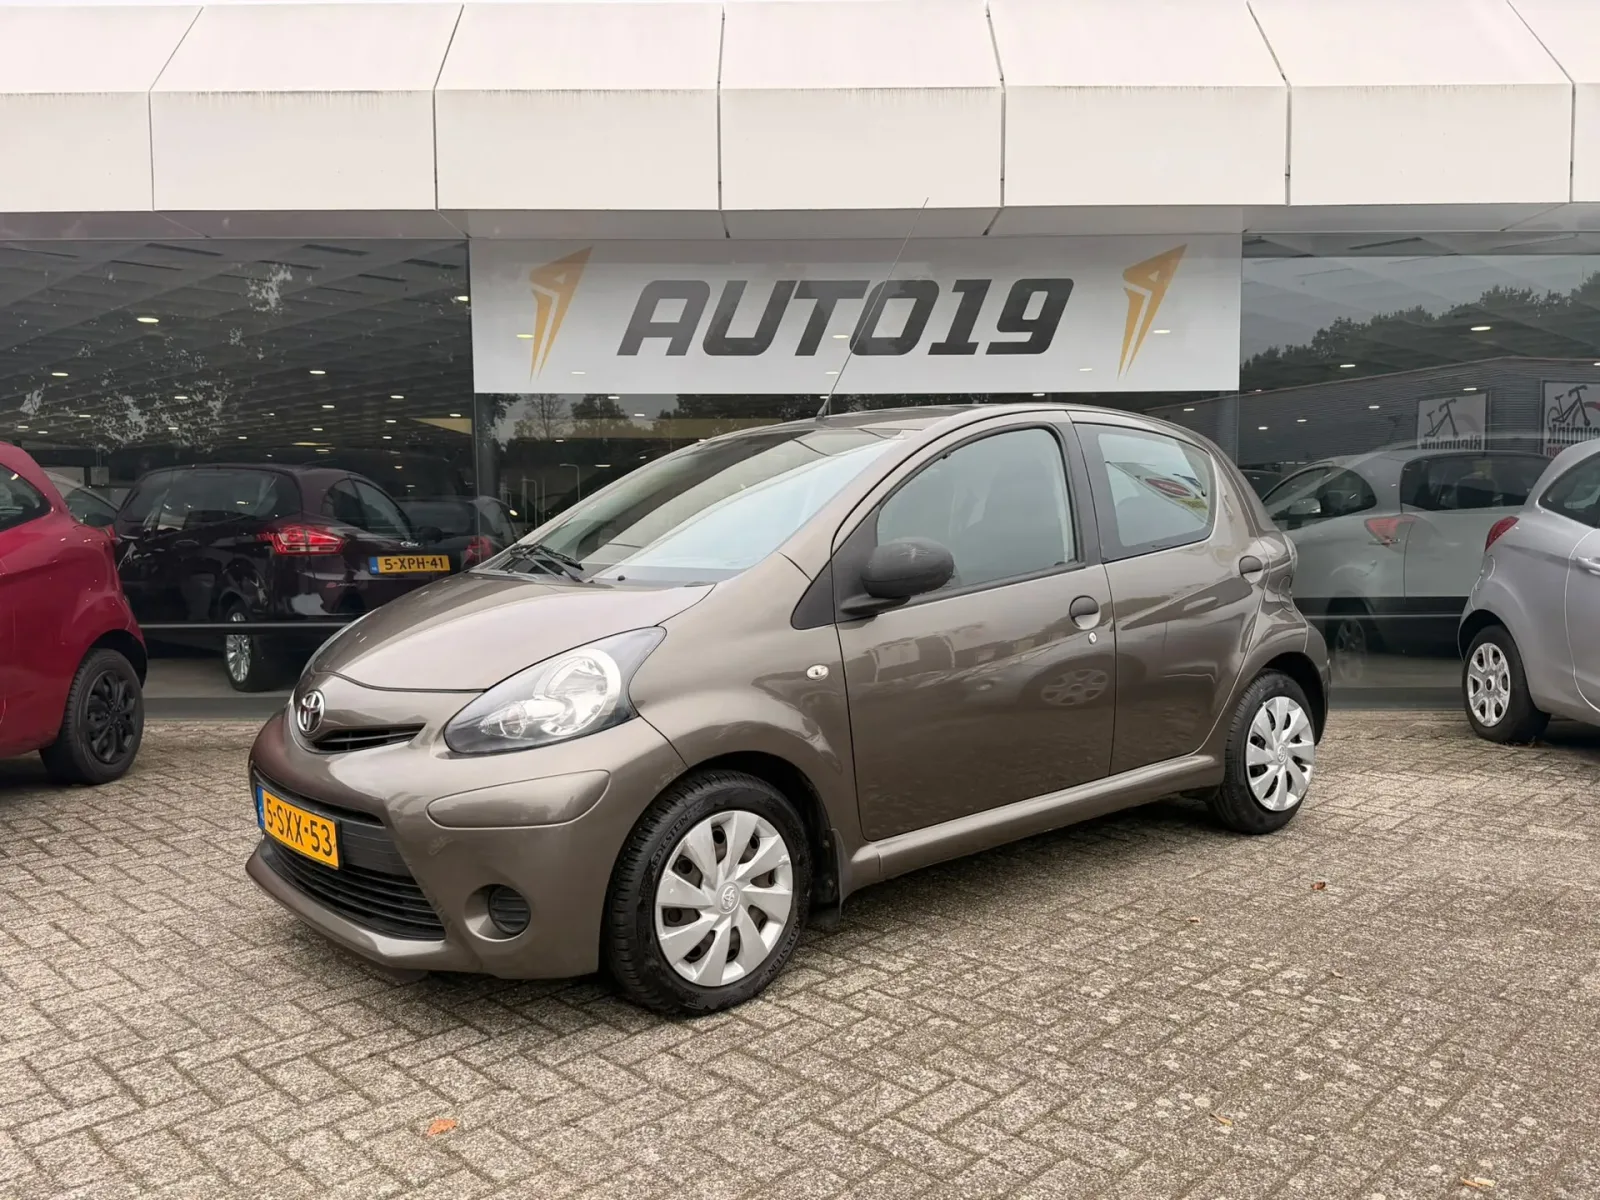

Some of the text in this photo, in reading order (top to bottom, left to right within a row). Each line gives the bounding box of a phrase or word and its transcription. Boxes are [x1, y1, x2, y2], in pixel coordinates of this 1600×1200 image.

[616, 278, 1075, 356] AUTO19
[384, 557, 445, 571] 5-XPH-41
[266, 797, 333, 857] 5-SXX-53
